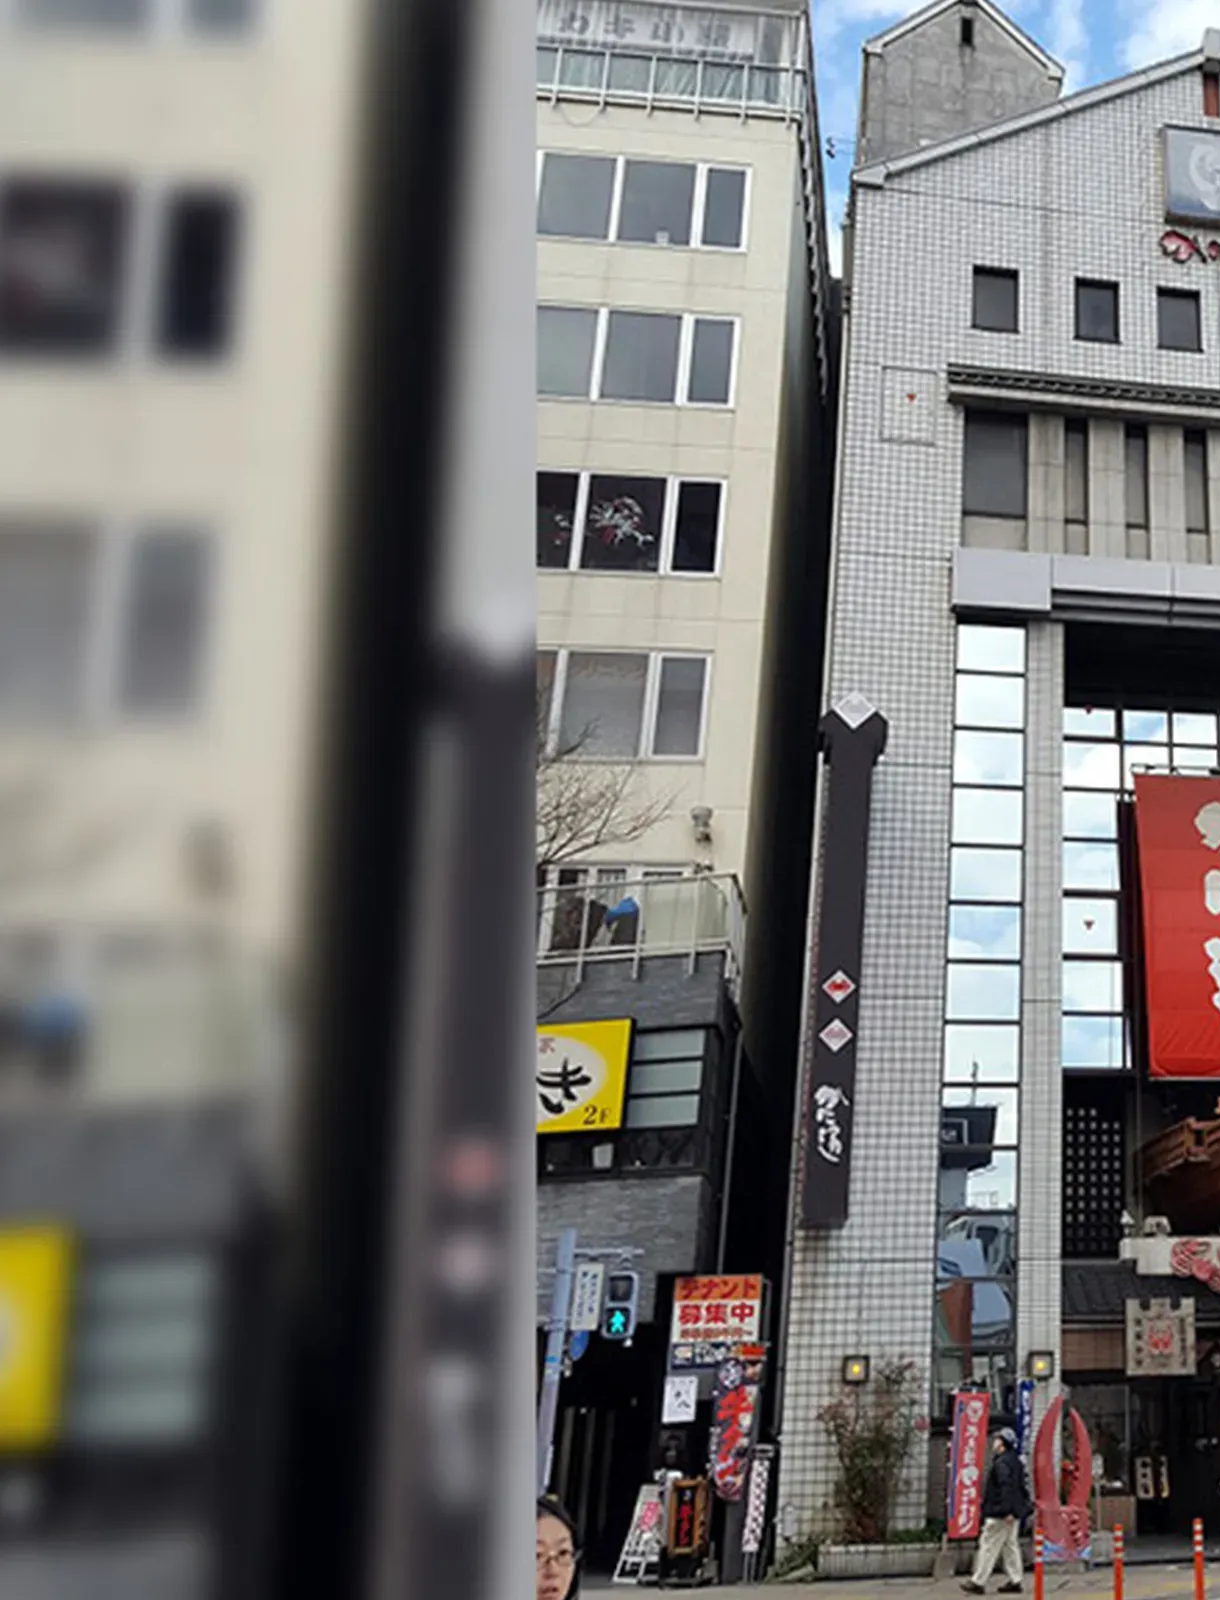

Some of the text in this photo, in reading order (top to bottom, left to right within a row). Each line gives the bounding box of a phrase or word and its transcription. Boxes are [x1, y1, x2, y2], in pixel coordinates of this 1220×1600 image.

[583, 1104, 612, 1126] 2F
[681, 1277, 759, 1300] テナント
[679, 1302, 755, 1325] 募集中
